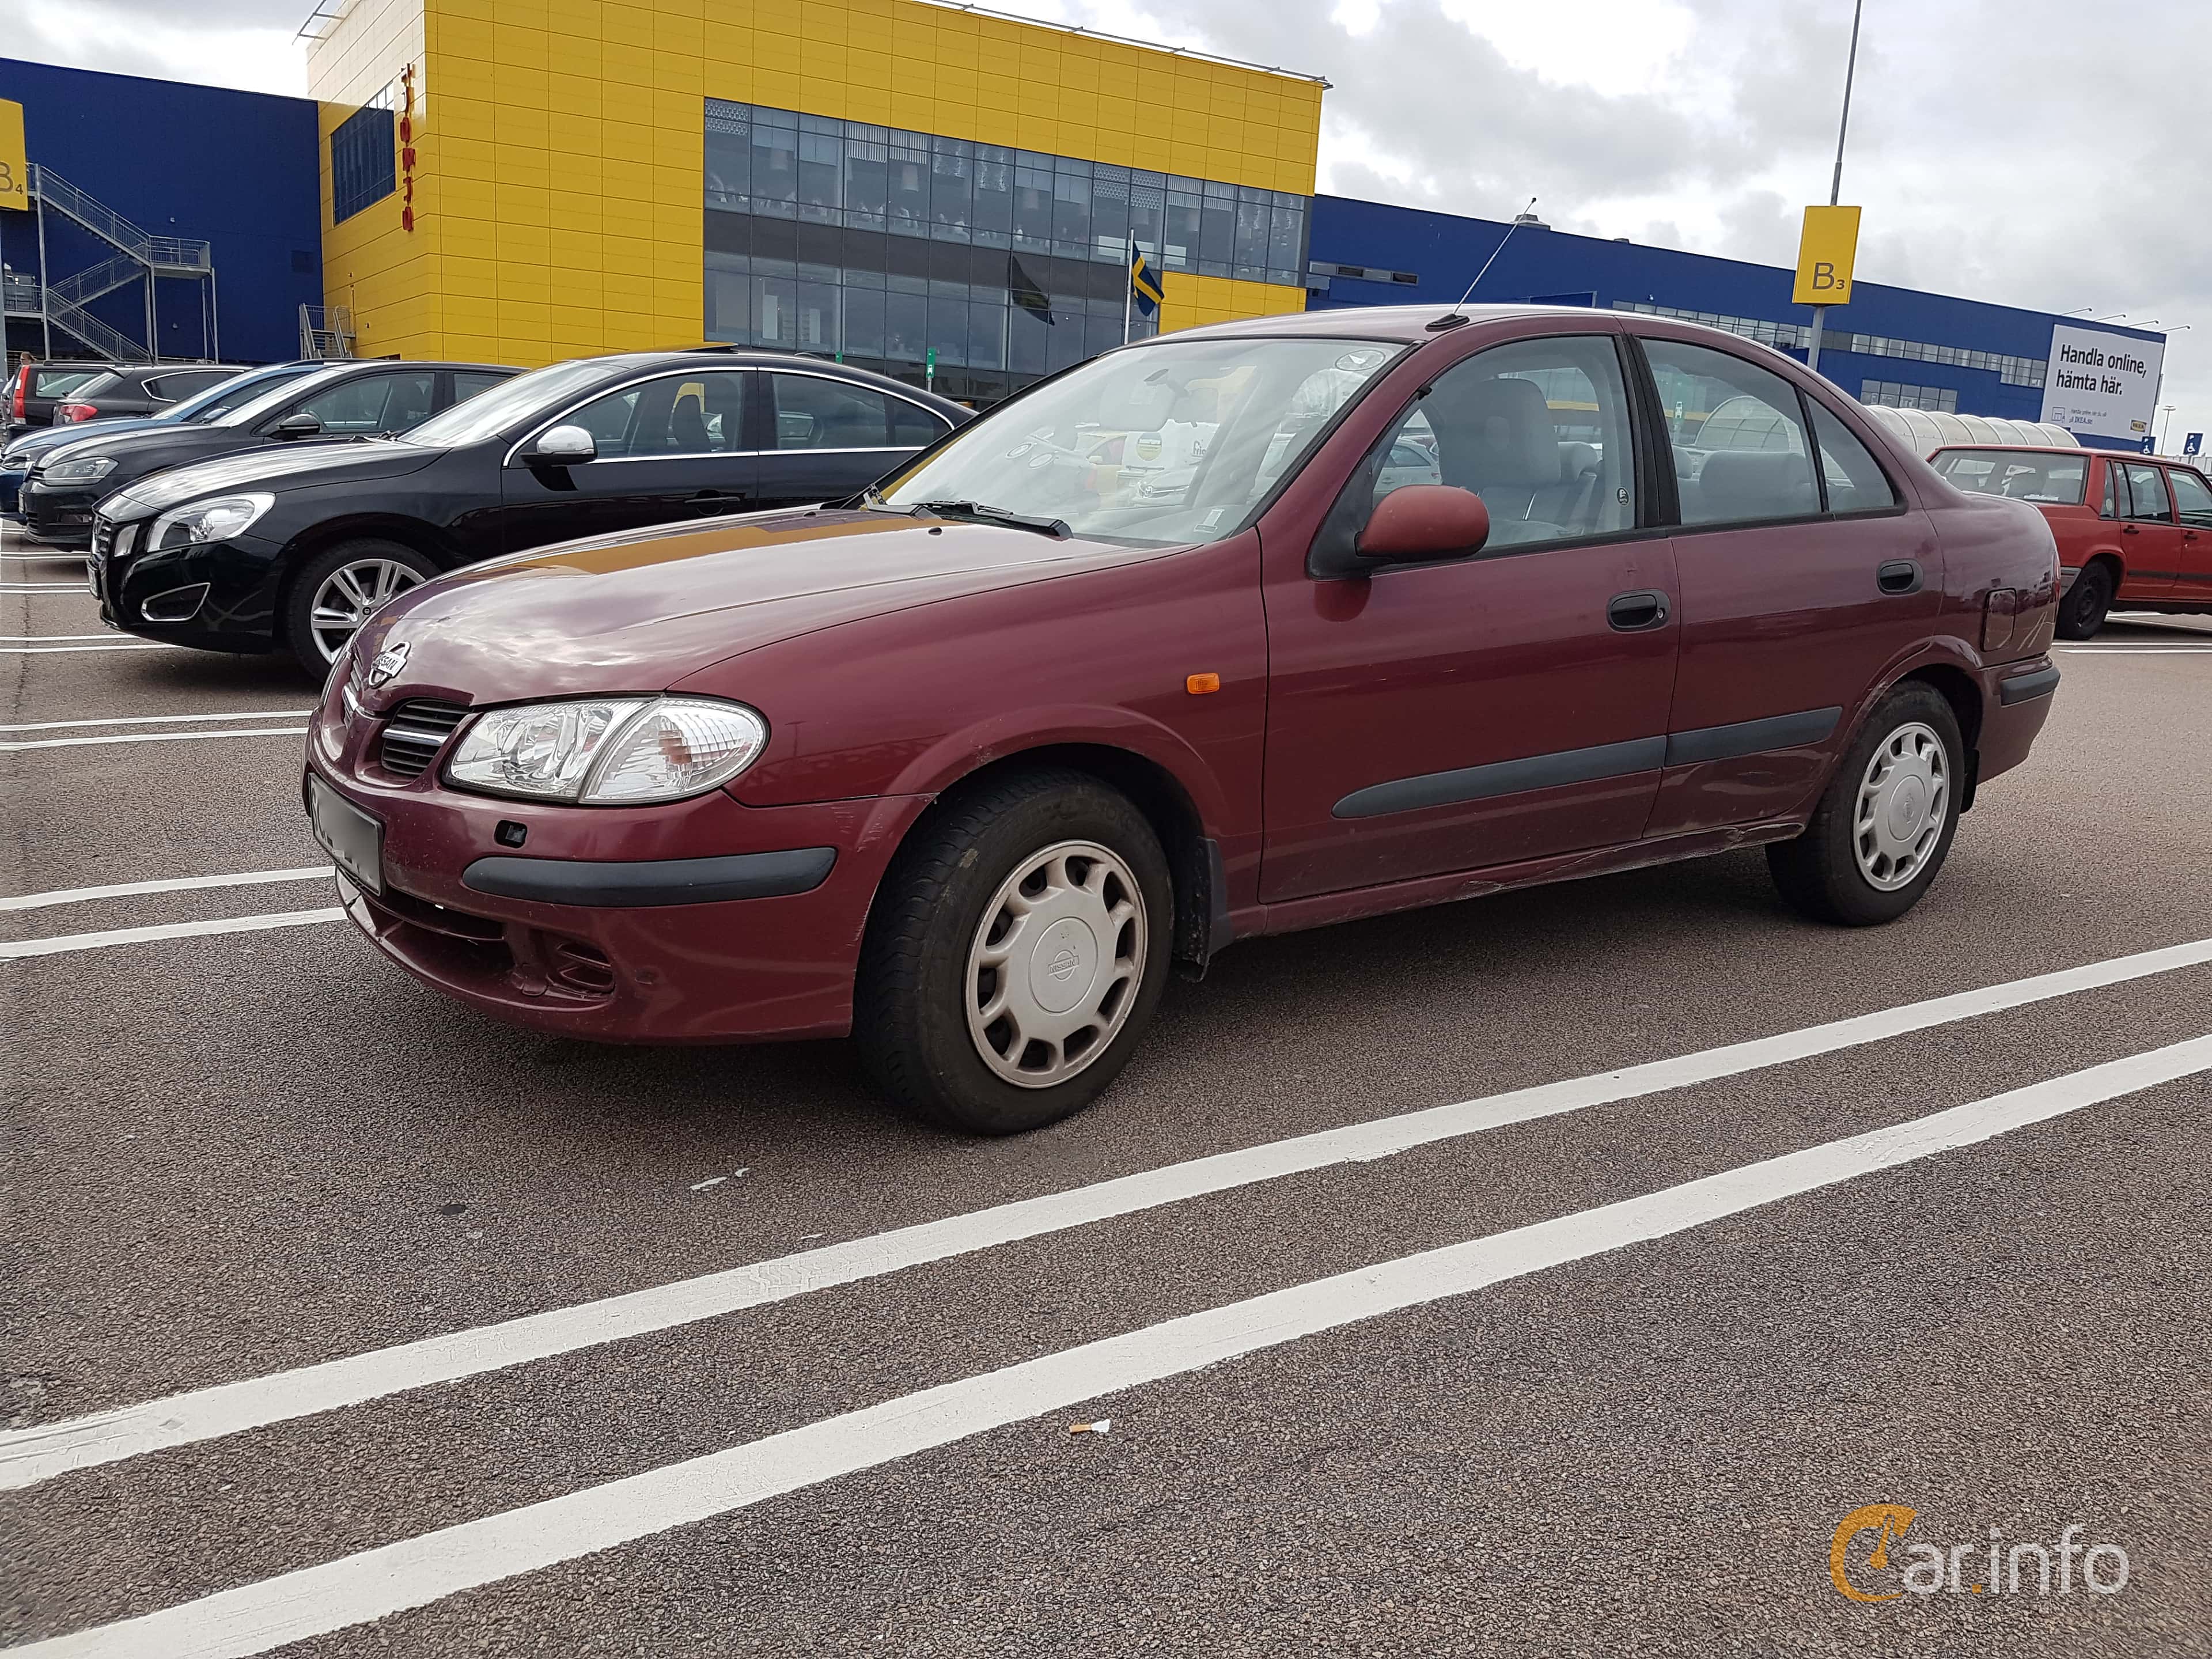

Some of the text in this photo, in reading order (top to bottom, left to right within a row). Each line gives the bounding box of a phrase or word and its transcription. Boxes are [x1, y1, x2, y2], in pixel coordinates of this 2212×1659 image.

[2060, 344, 2147, 378] Handla online,
[2056, 369, 2123, 395] hämta här.
[1050, 959, 1075, 974] NISSAN
